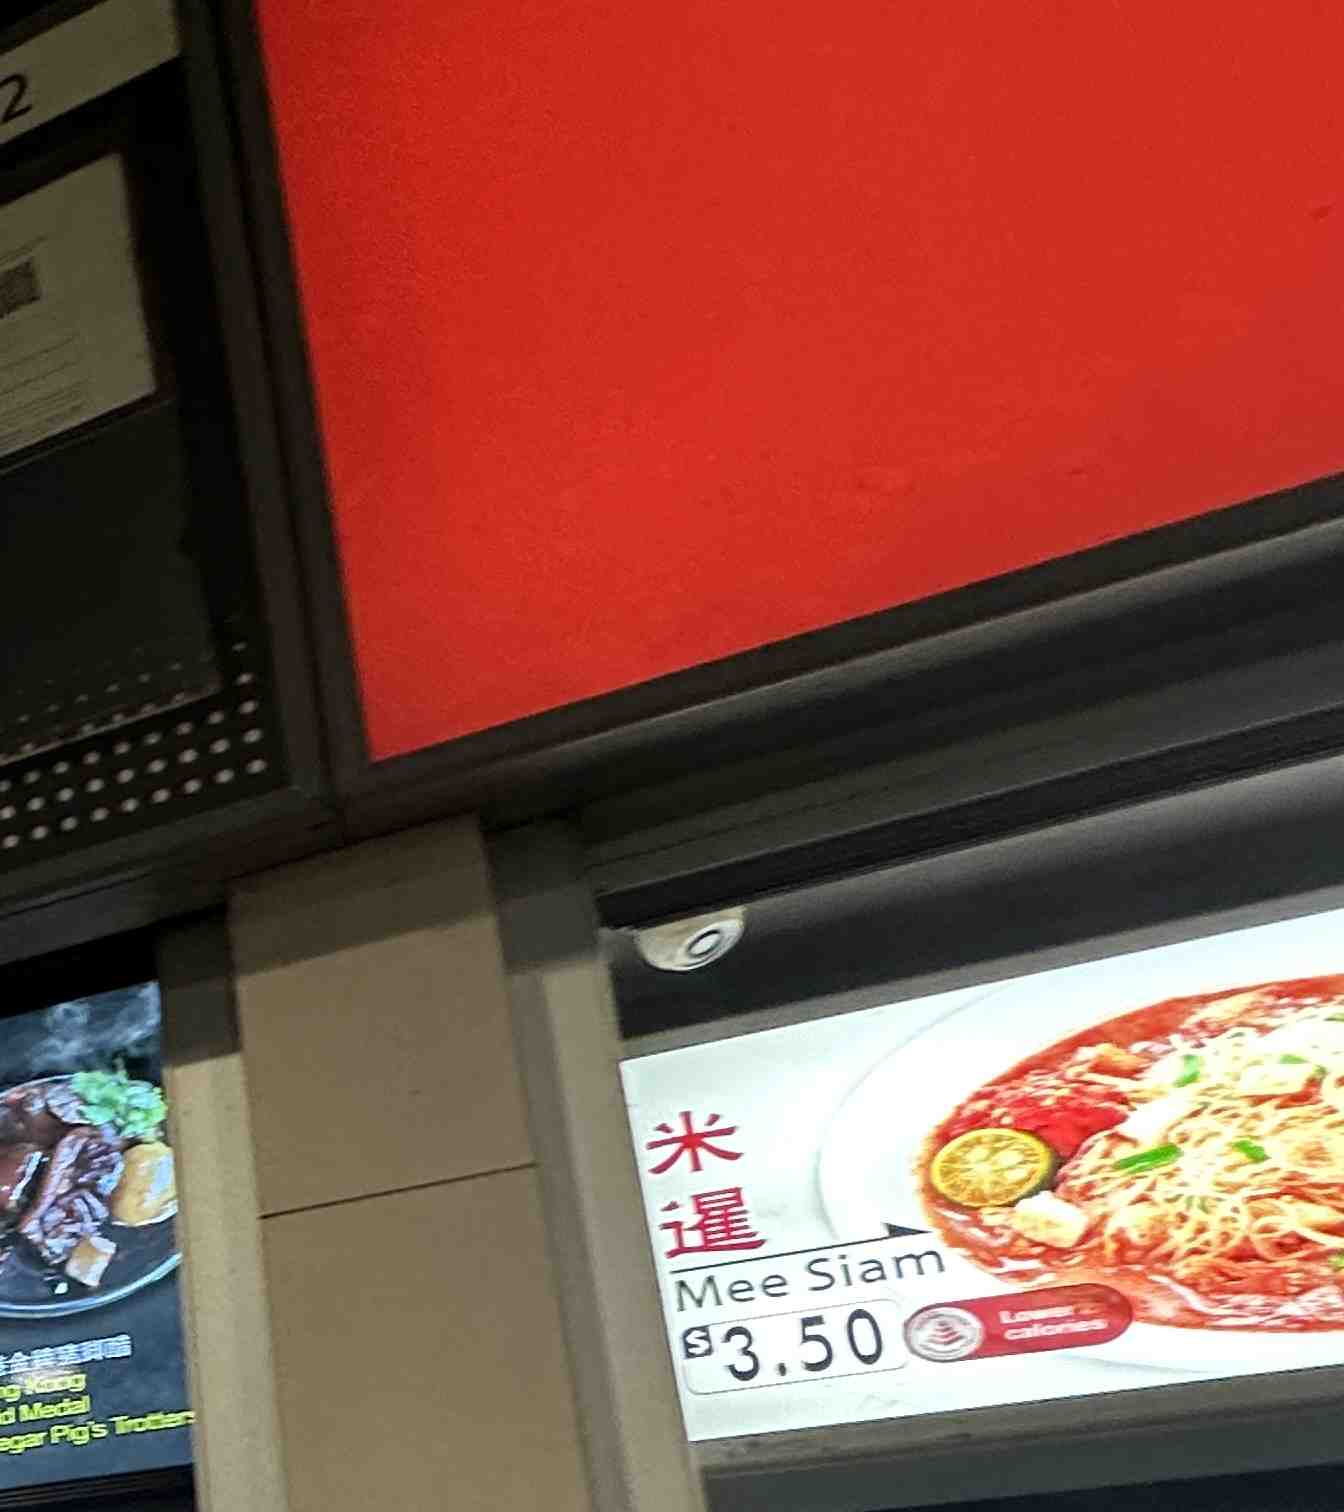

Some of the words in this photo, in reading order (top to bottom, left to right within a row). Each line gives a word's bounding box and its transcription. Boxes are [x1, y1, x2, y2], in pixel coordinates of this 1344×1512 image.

[675, 1273, 792, 1314] Mee
[806, 1249, 947, 1293] Siam
[1003, 1319, 1110, 1341] calories
[18, 1394, 91, 1422] Medal
[50, 1420, 110, 1446] Pig's
